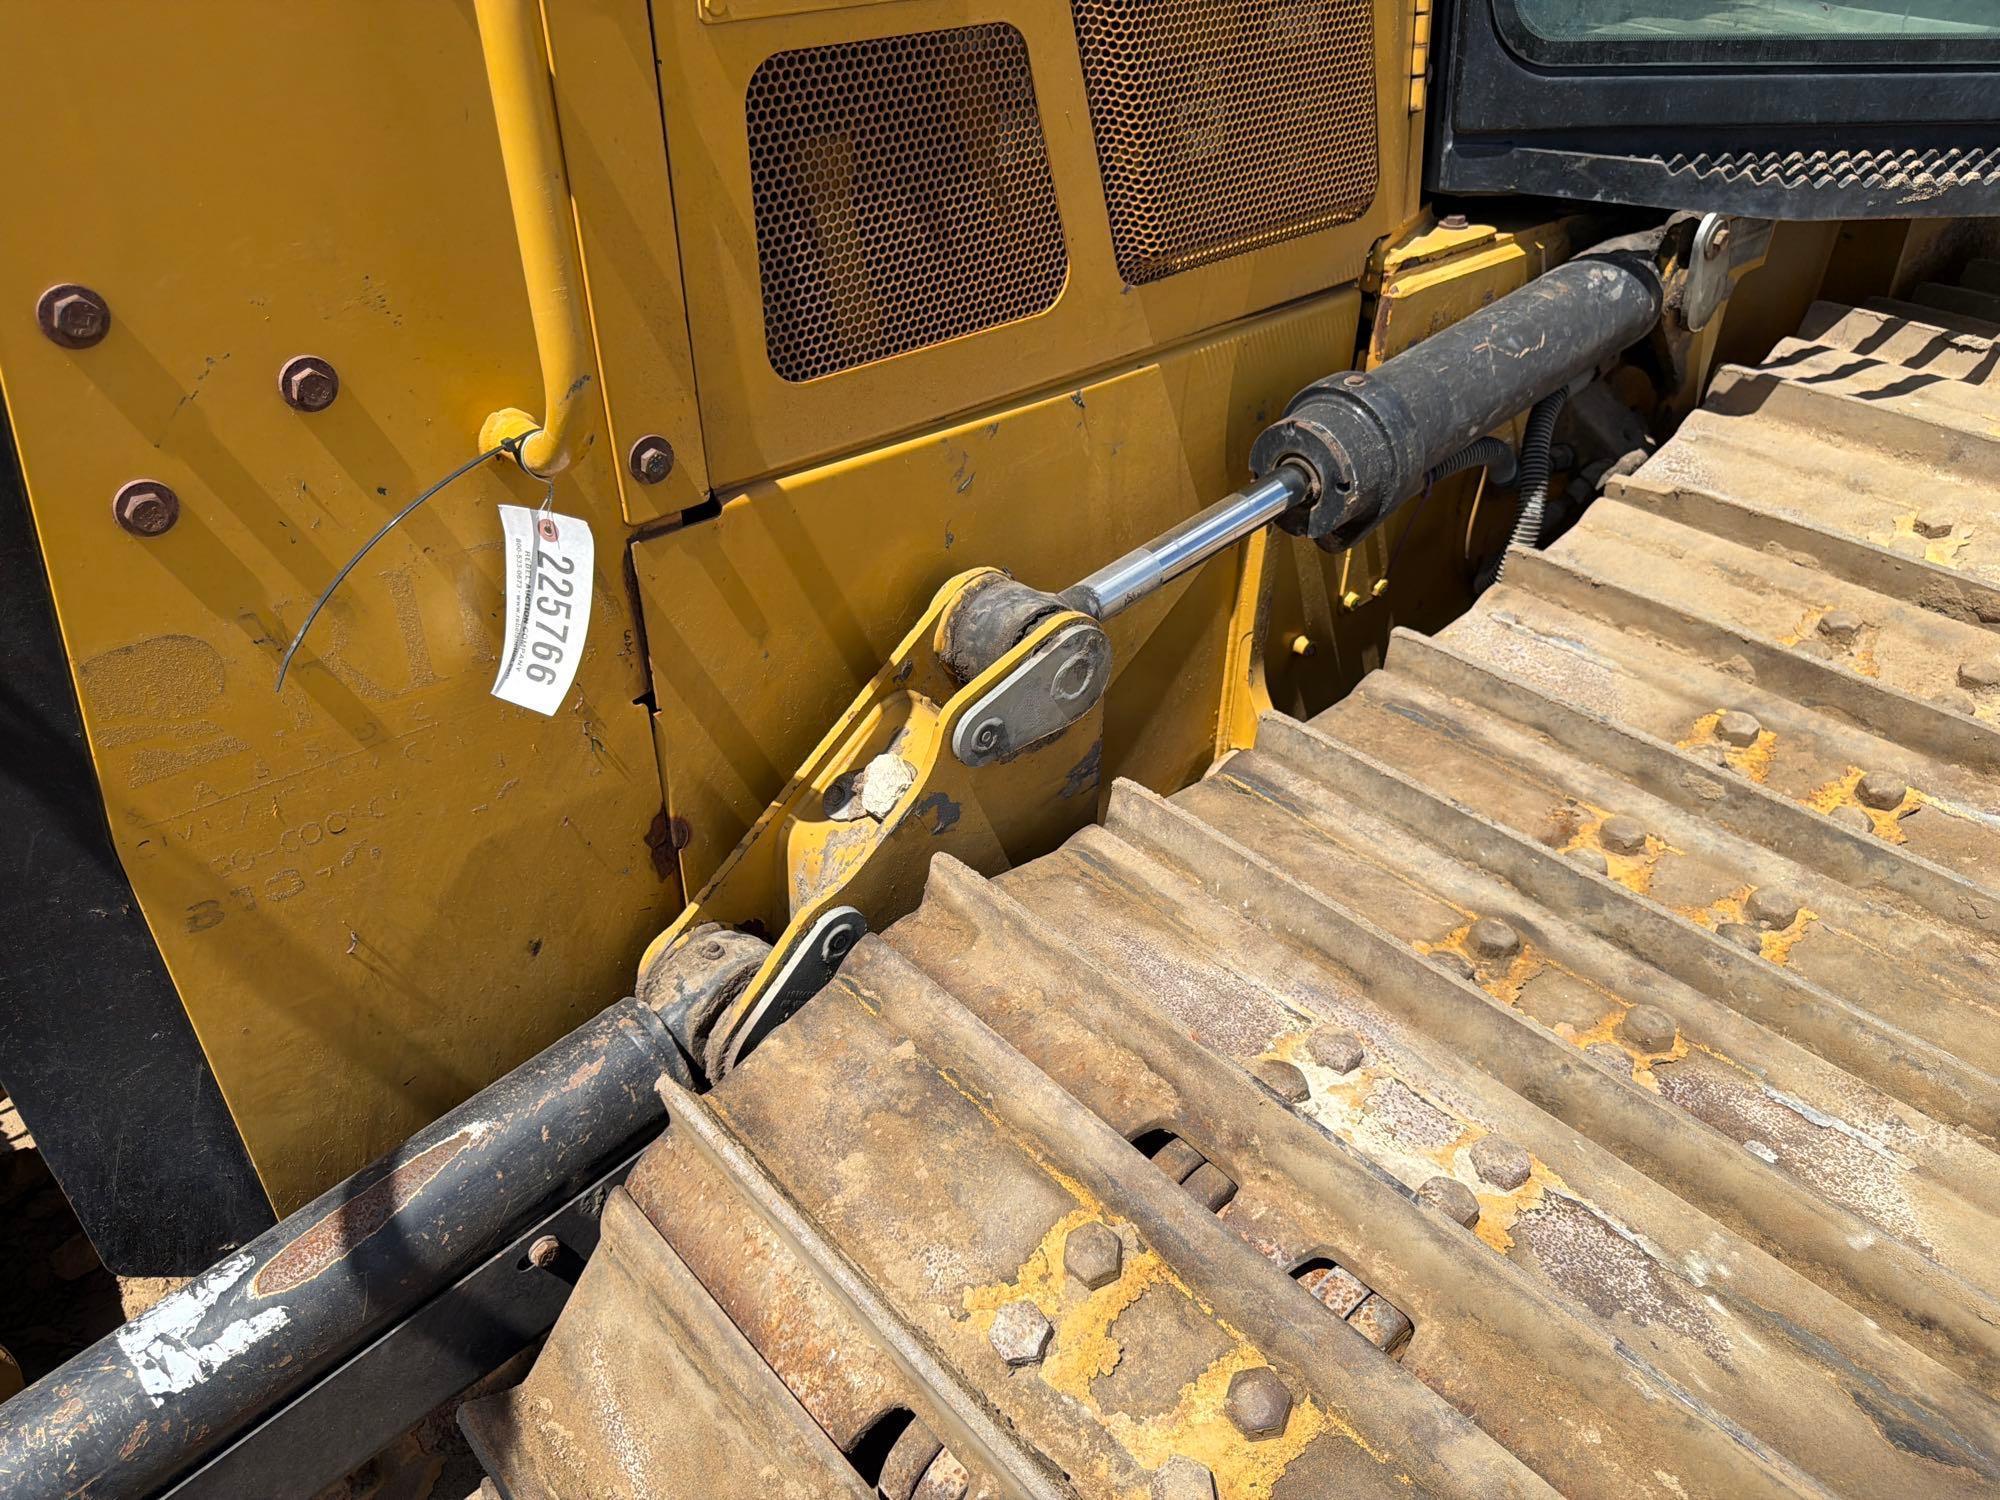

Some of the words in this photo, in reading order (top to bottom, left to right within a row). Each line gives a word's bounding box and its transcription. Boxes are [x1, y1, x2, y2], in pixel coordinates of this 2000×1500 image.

[524, 550, 532, 582] REBEL
[522, 582, 532, 625] AUCTION
[526, 550, 575, 686] 225766
[515, 625, 529, 673] COMPANY
